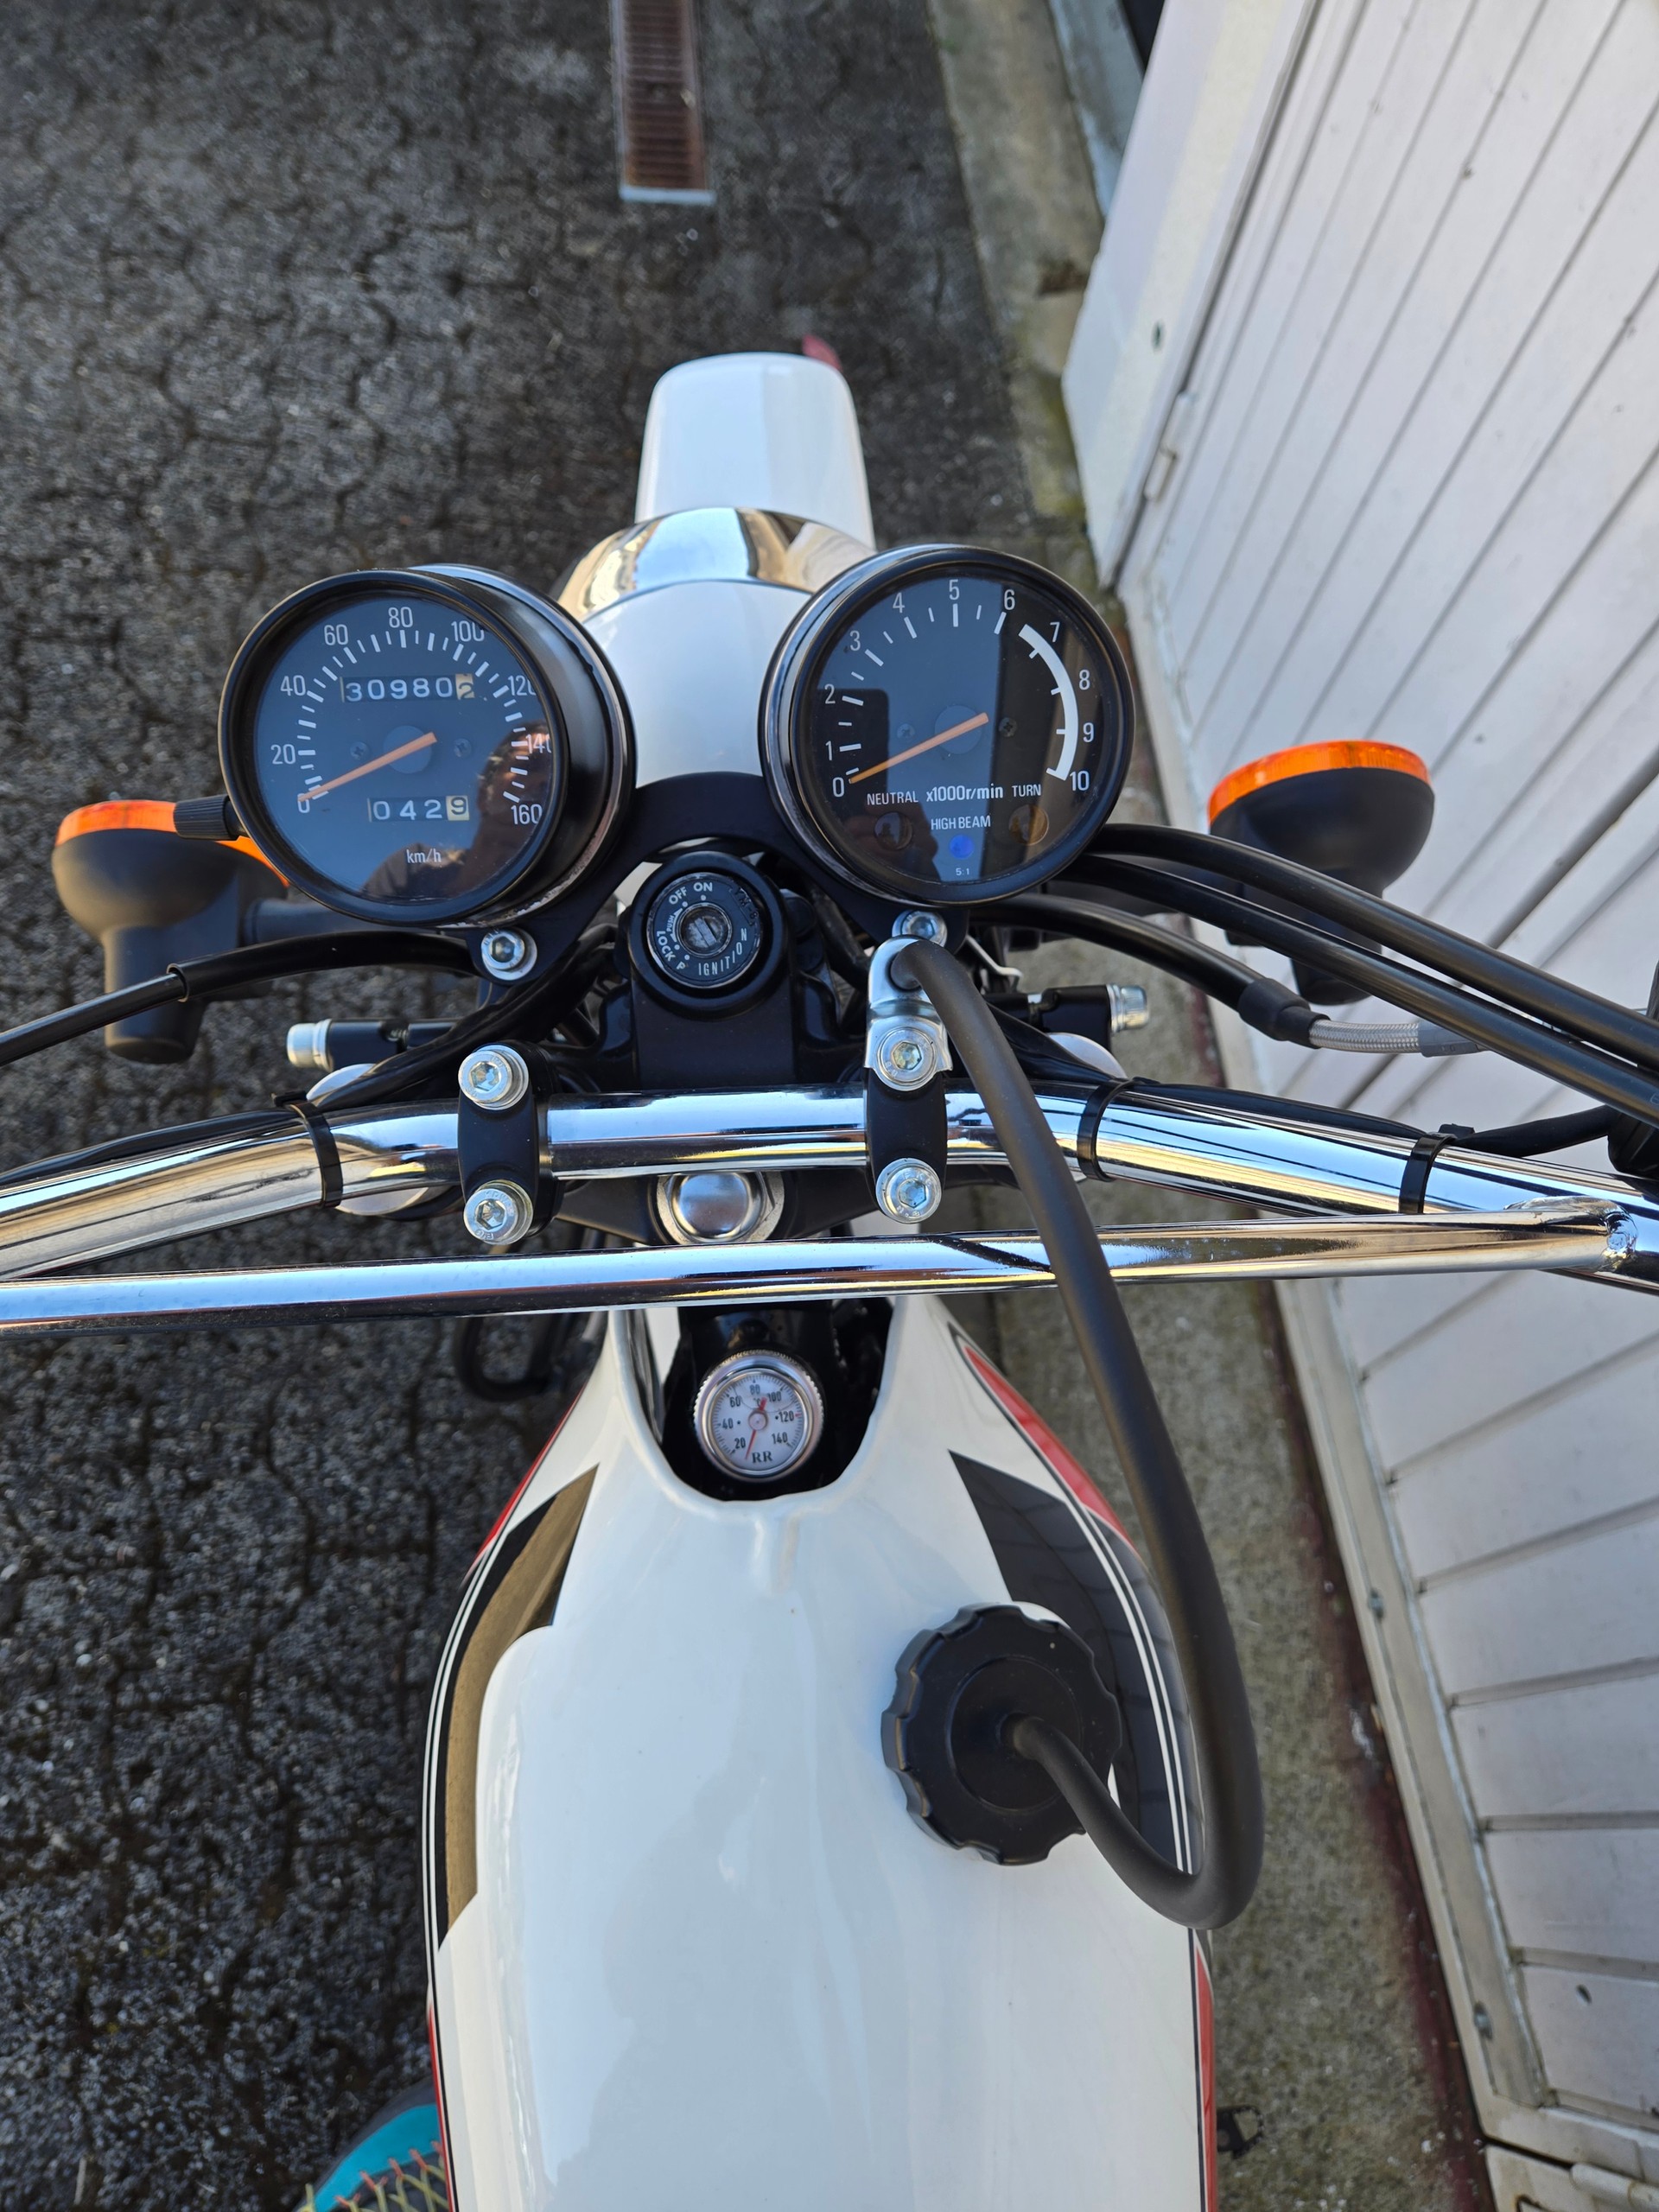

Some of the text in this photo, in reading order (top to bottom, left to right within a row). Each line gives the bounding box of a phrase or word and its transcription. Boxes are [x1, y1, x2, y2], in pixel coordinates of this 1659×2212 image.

[949, 579, 960, 601] 5
[1003, 589, 1016, 610] 6
[892, 593, 906, 613] 4
[388, 607, 414, 628] 80
[324, 624, 349, 646] 60
[849, 630, 861, 652] 3
[1050, 621, 1061, 643] 7
[280, 675, 307, 697] 40
[1079, 669, 1091, 690] 8
[823, 683, 836, 705] 2
[1083, 721, 1095, 743] 9
[270, 744, 296, 766] 20
[825, 741, 833, 761] 1
[832, 777, 845, 798] 0
[1069, 770, 1090, 791] 10
[867, 784, 1041, 805] NEUTRAL x1000r/min TURN
[372, 797, 467, 820] 0429
[511, 804, 543, 825] 160
[931, 815, 991, 830] HIGH BEAM
[406, 848, 442, 864] km/h
[668, 887, 688, 905] OFF
[693, 881, 713, 893] ON
[666, 914, 675, 932] PUSH
[657, 931, 676, 962] LOCK
[698, 928, 747, 976] IGNITION
[676, 961, 686, 970] P
[750, 1383, 761, 1394] 80
[767, 1391, 782, 1402] 100
[729, 1396, 741, 1408] 60
[722, 1418, 734, 1429] 40
[779, 1411, 794, 1422] 120
[734, 1437, 746, 1449] 20
[772, 1432, 788, 1445] 140
[752, 1451, 773, 1463] RR
